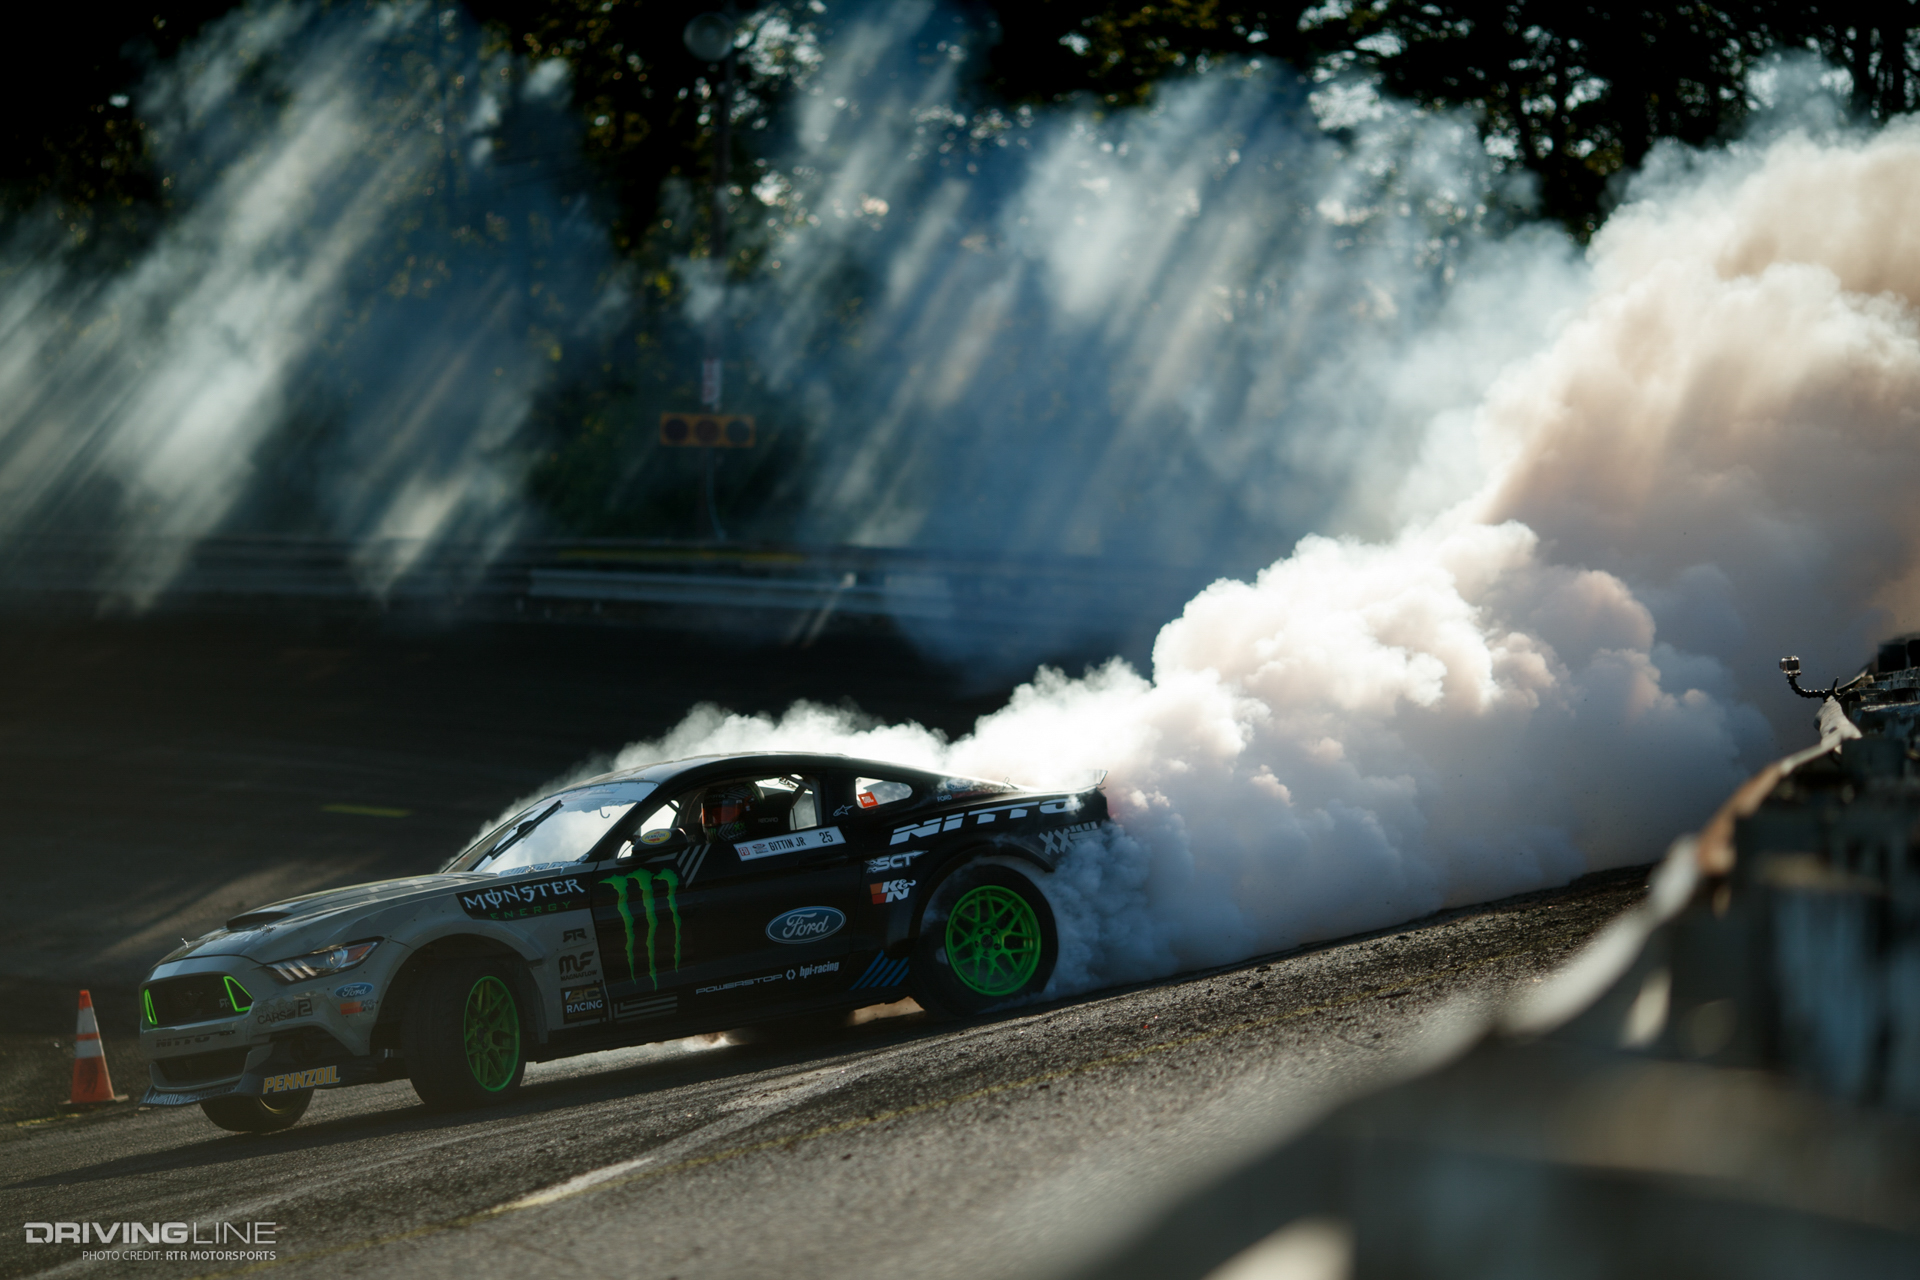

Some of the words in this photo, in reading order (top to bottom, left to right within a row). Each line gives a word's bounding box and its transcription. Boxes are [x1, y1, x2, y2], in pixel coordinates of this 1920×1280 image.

[889, 798, 1082, 845] NITTO
[768, 839, 795, 852] GITTIN
[795, 836, 806, 847] JR
[819, 831, 834, 844] 25
[872, 851, 920, 872] SCT
[462, 878, 586, 911] MONSTER
[490, 900, 571, 920] ENERGY
[782, 912, 829, 939] Ford
[560, 969, 598, 982] MAGNAFLOW
[696, 973, 783, 995] POWERSTOP
[799, 961, 840, 979] hpi-racing
[257, 1010, 287, 1025] CARS
[299, 1000, 312, 1017] 2
[566, 999, 604, 1014] RACING
[262, 1065, 341, 1095] PENNZOIL
